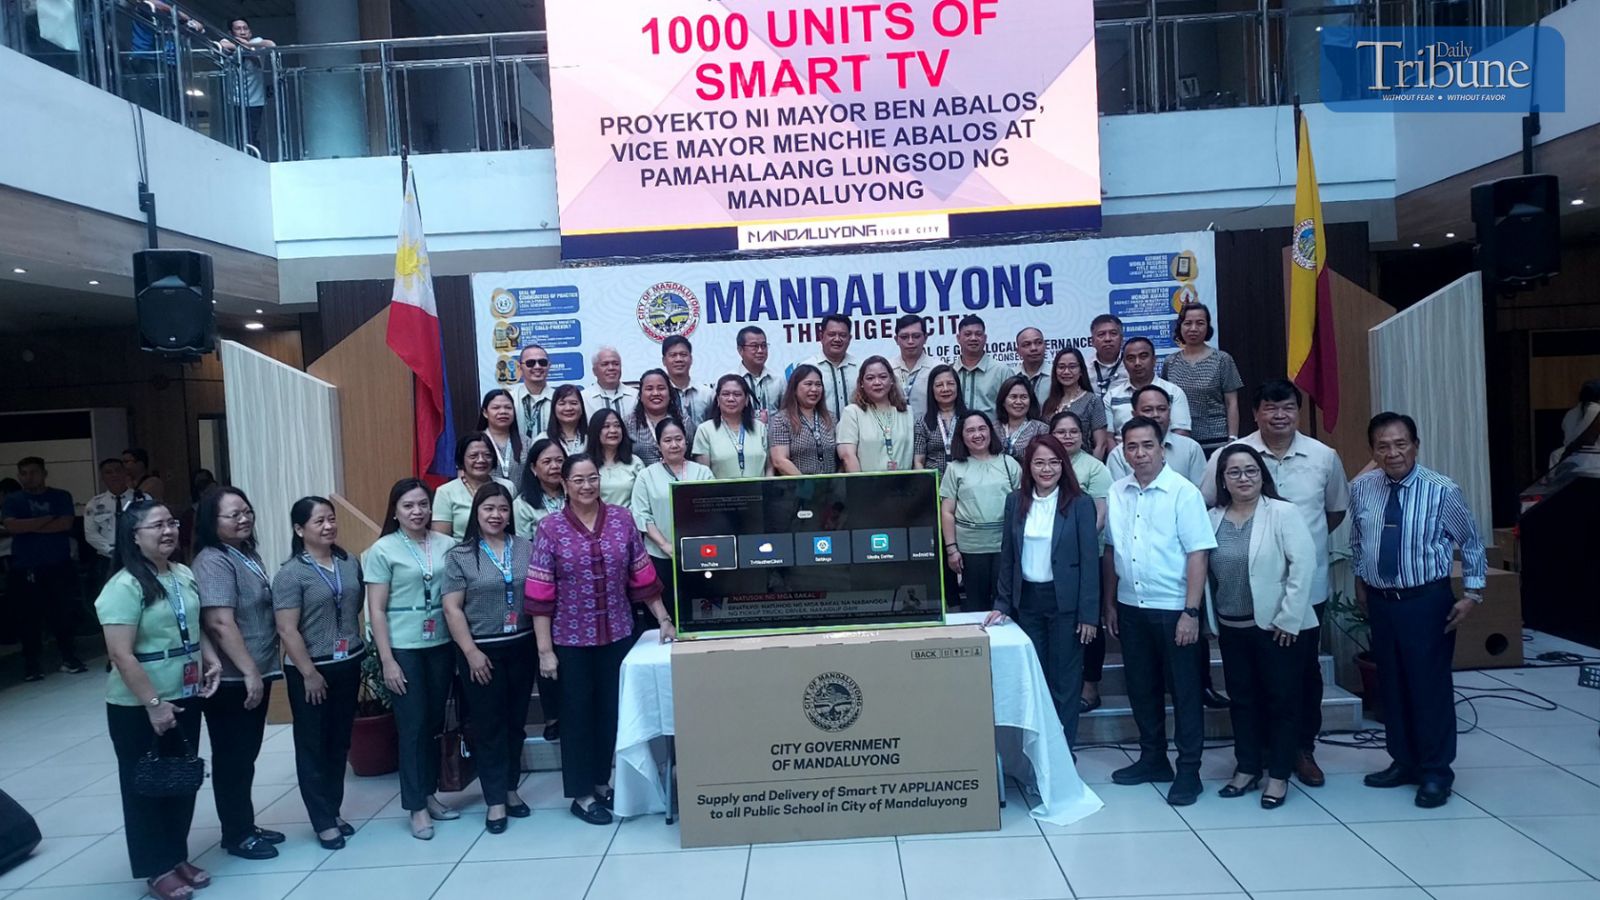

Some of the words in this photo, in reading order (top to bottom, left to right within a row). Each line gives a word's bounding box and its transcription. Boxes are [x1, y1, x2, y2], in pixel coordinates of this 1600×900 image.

[642, 12, 749, 55] 1000
[767, 3, 915, 48] UNITS
[932, 0, 999, 38] OF
[695, 55, 871, 101] SMART
[886, 49, 950, 89] TV
[600, 110, 737, 136] PROYEKTO
[746, 108, 769, 128] NI
[778, 103, 867, 126] MAYOR
[874, 99, 925, 121] BEN
[932, 92, 1044, 117] ABALOS,
[611, 141, 668, 162] VICE
[676, 135, 765, 159] MAYOR
[773, 128, 886, 154] MENCHIE
[893, 121, 998, 147] ABALOS
[1004, 119, 1036, 140] AT
[641, 158, 834, 188] PAMAHALAANG
[842, 151, 965, 176] LUNGSOD
[973, 148, 1009, 168] NG
[728, 180, 924, 210] MANDALUYONG
[748, 225, 877, 243] MANDALUYONG
[880, 227, 910, 236] TIGER
[916, 226, 940, 234] CITY
[638, 302, 646, 320] CITY
[642, 292, 651, 301] OF
[652, 283, 699, 318] MANDALUYONG
[705, 262, 1054, 324] MANDALUYONG
[925, 314, 976, 336] CIT
[937, 346, 949, 357] OF
[915, 650, 937, 658] BACK
[809, 680, 817, 690] OF
[818, 673, 862, 707] MANDALUYONG
[770, 743, 801, 756] CITY
[804, 737, 901, 754] GOVERNMENT
[772, 759, 791, 771] OF
[793, 753, 900, 771] MANDALUYONG
[697, 793, 739, 807] Supply
[742, 791, 766, 802] and
[768, 789, 819, 801] Delivery
[822, 786, 836, 799] of
[837, 785, 877, 797] Smart
[880, 783, 897, 794] TV
[899, 779, 979, 794] APPLIANCES
[710, 809, 723, 819] to
[726, 807, 740, 818] all
[743, 805, 780, 818] Public
[783, 802, 825, 815] School
[827, 802, 838, 812] in
[841, 800, 866, 813] City
[869, 799, 882, 812] of
[884, 797, 968, 809] Mandaluyong
